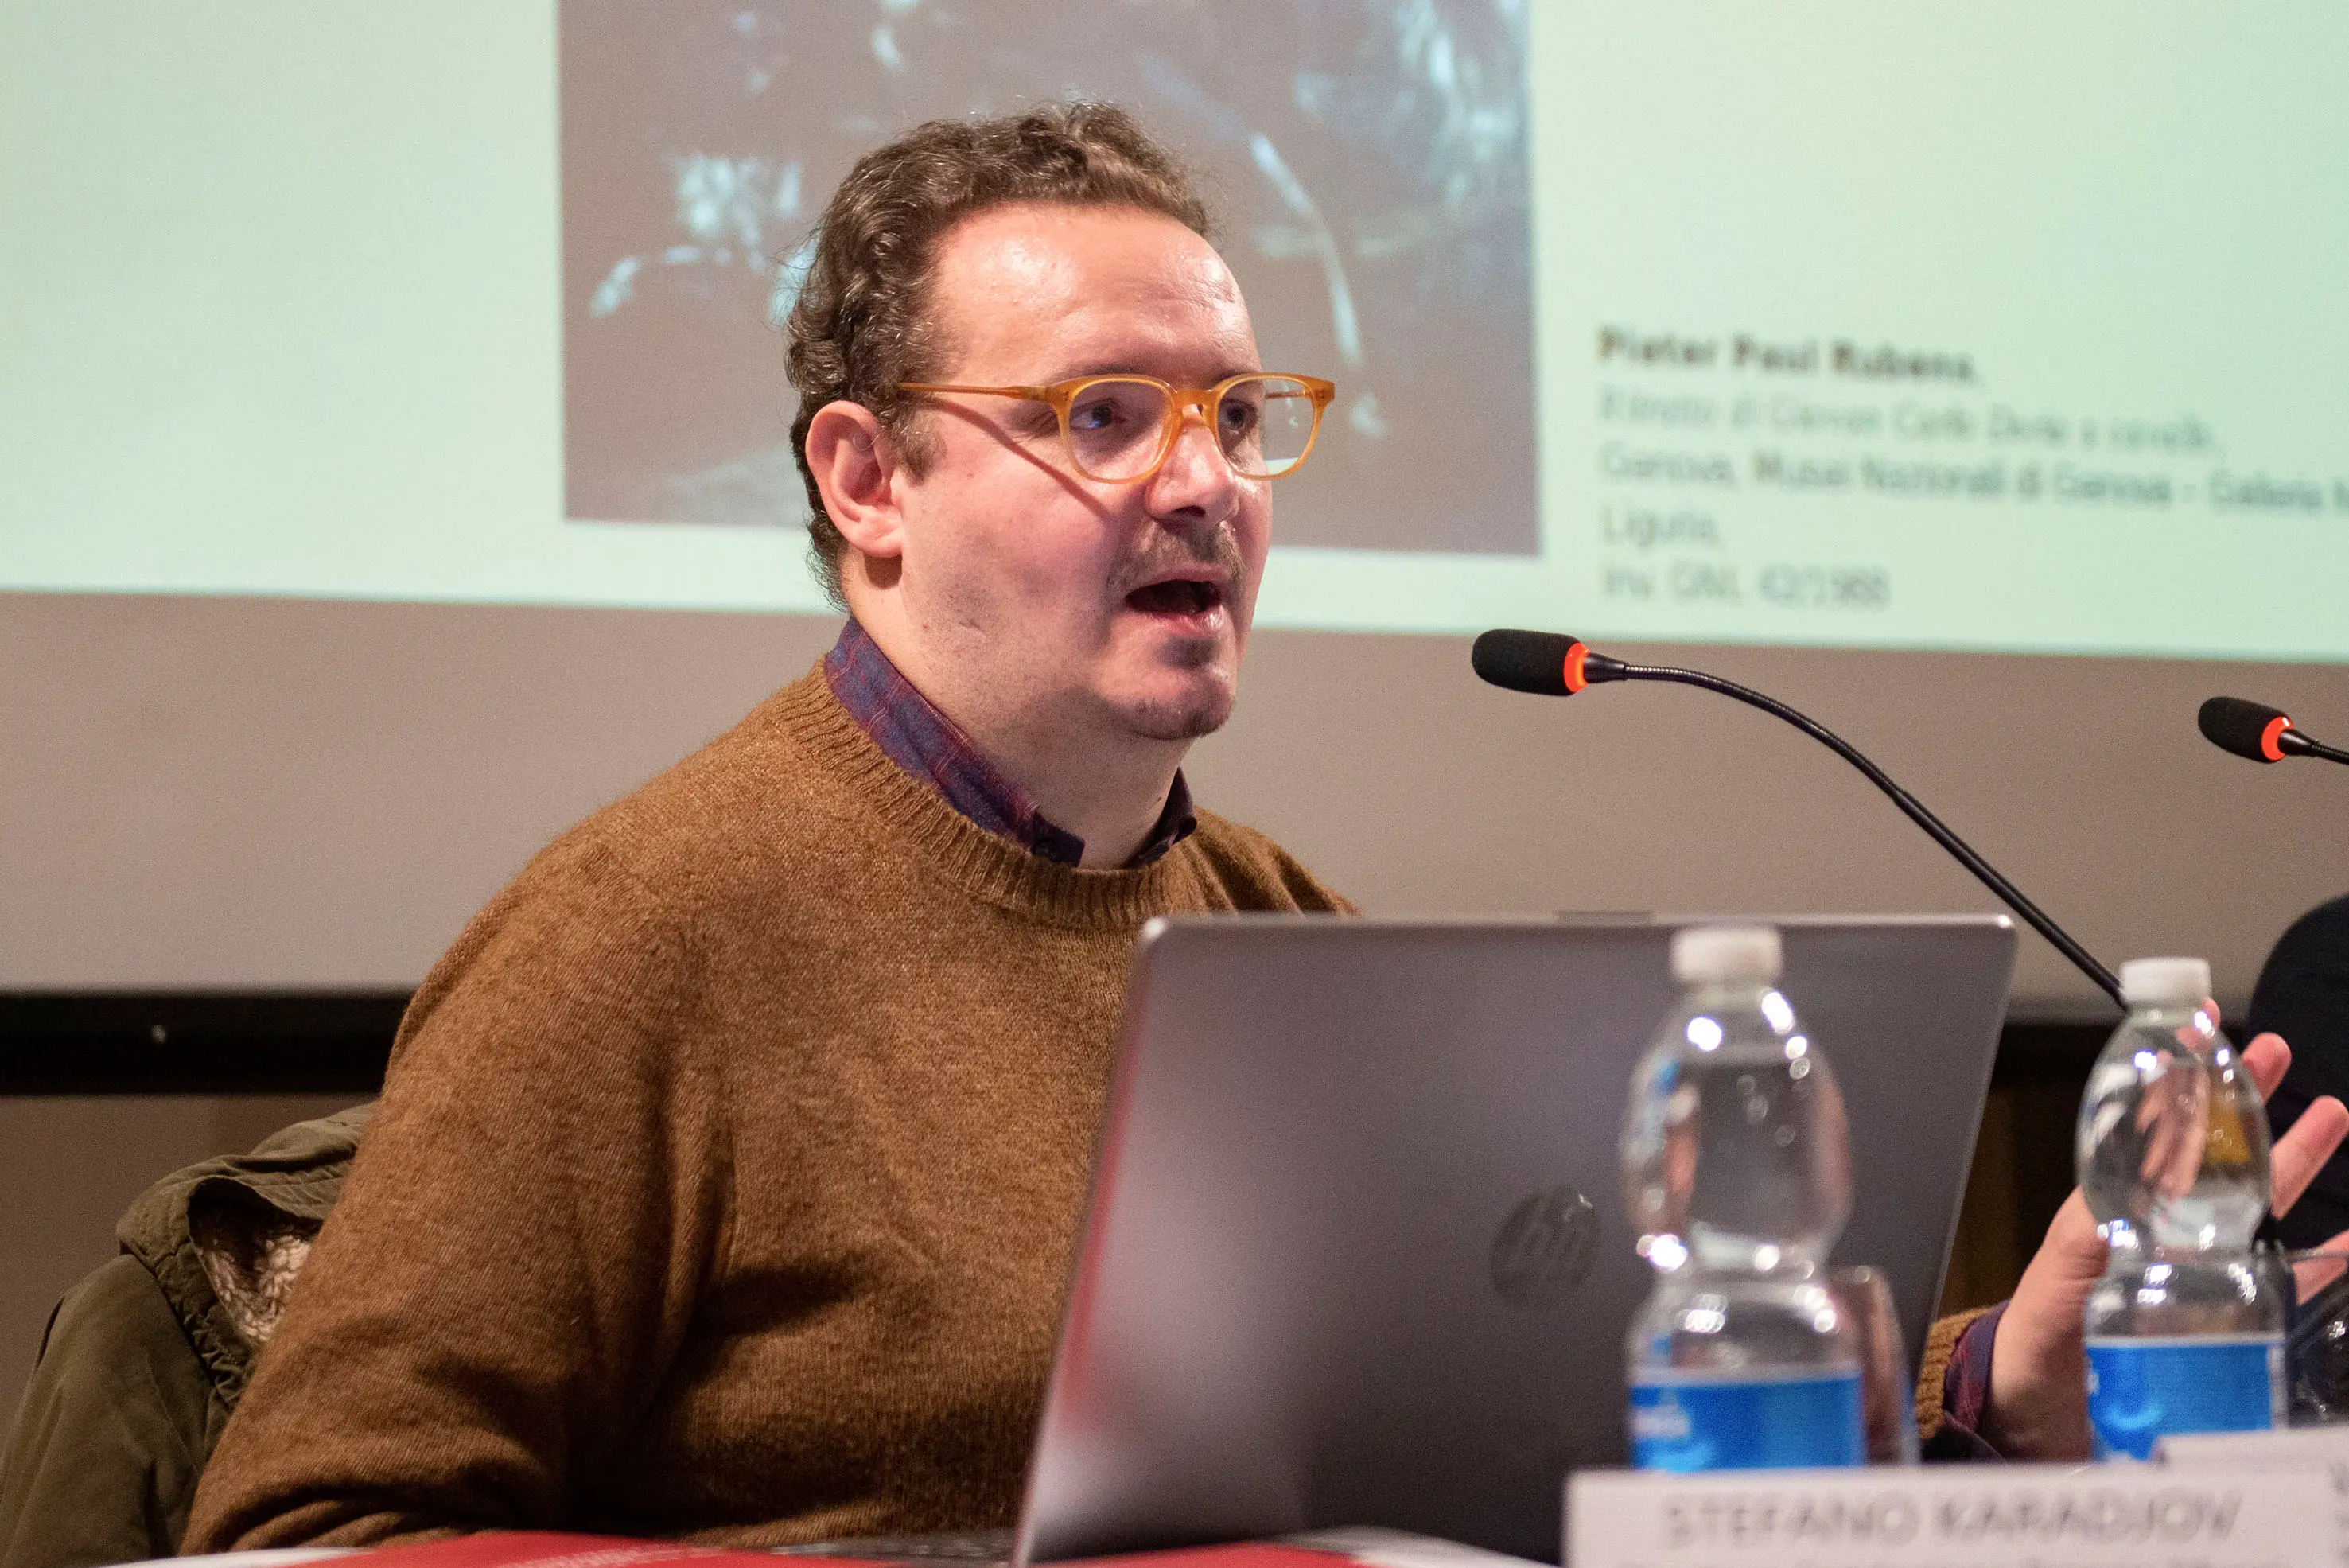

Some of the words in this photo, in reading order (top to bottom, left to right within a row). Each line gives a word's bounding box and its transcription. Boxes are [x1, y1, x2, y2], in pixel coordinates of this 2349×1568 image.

[1598, 325, 1717, 367] Pieter
[1733, 331, 1818, 371] Paul
[1664, 1492, 1919, 1547] STEFANO
[1936, 1489, 2242, 1545] KARADJOV
